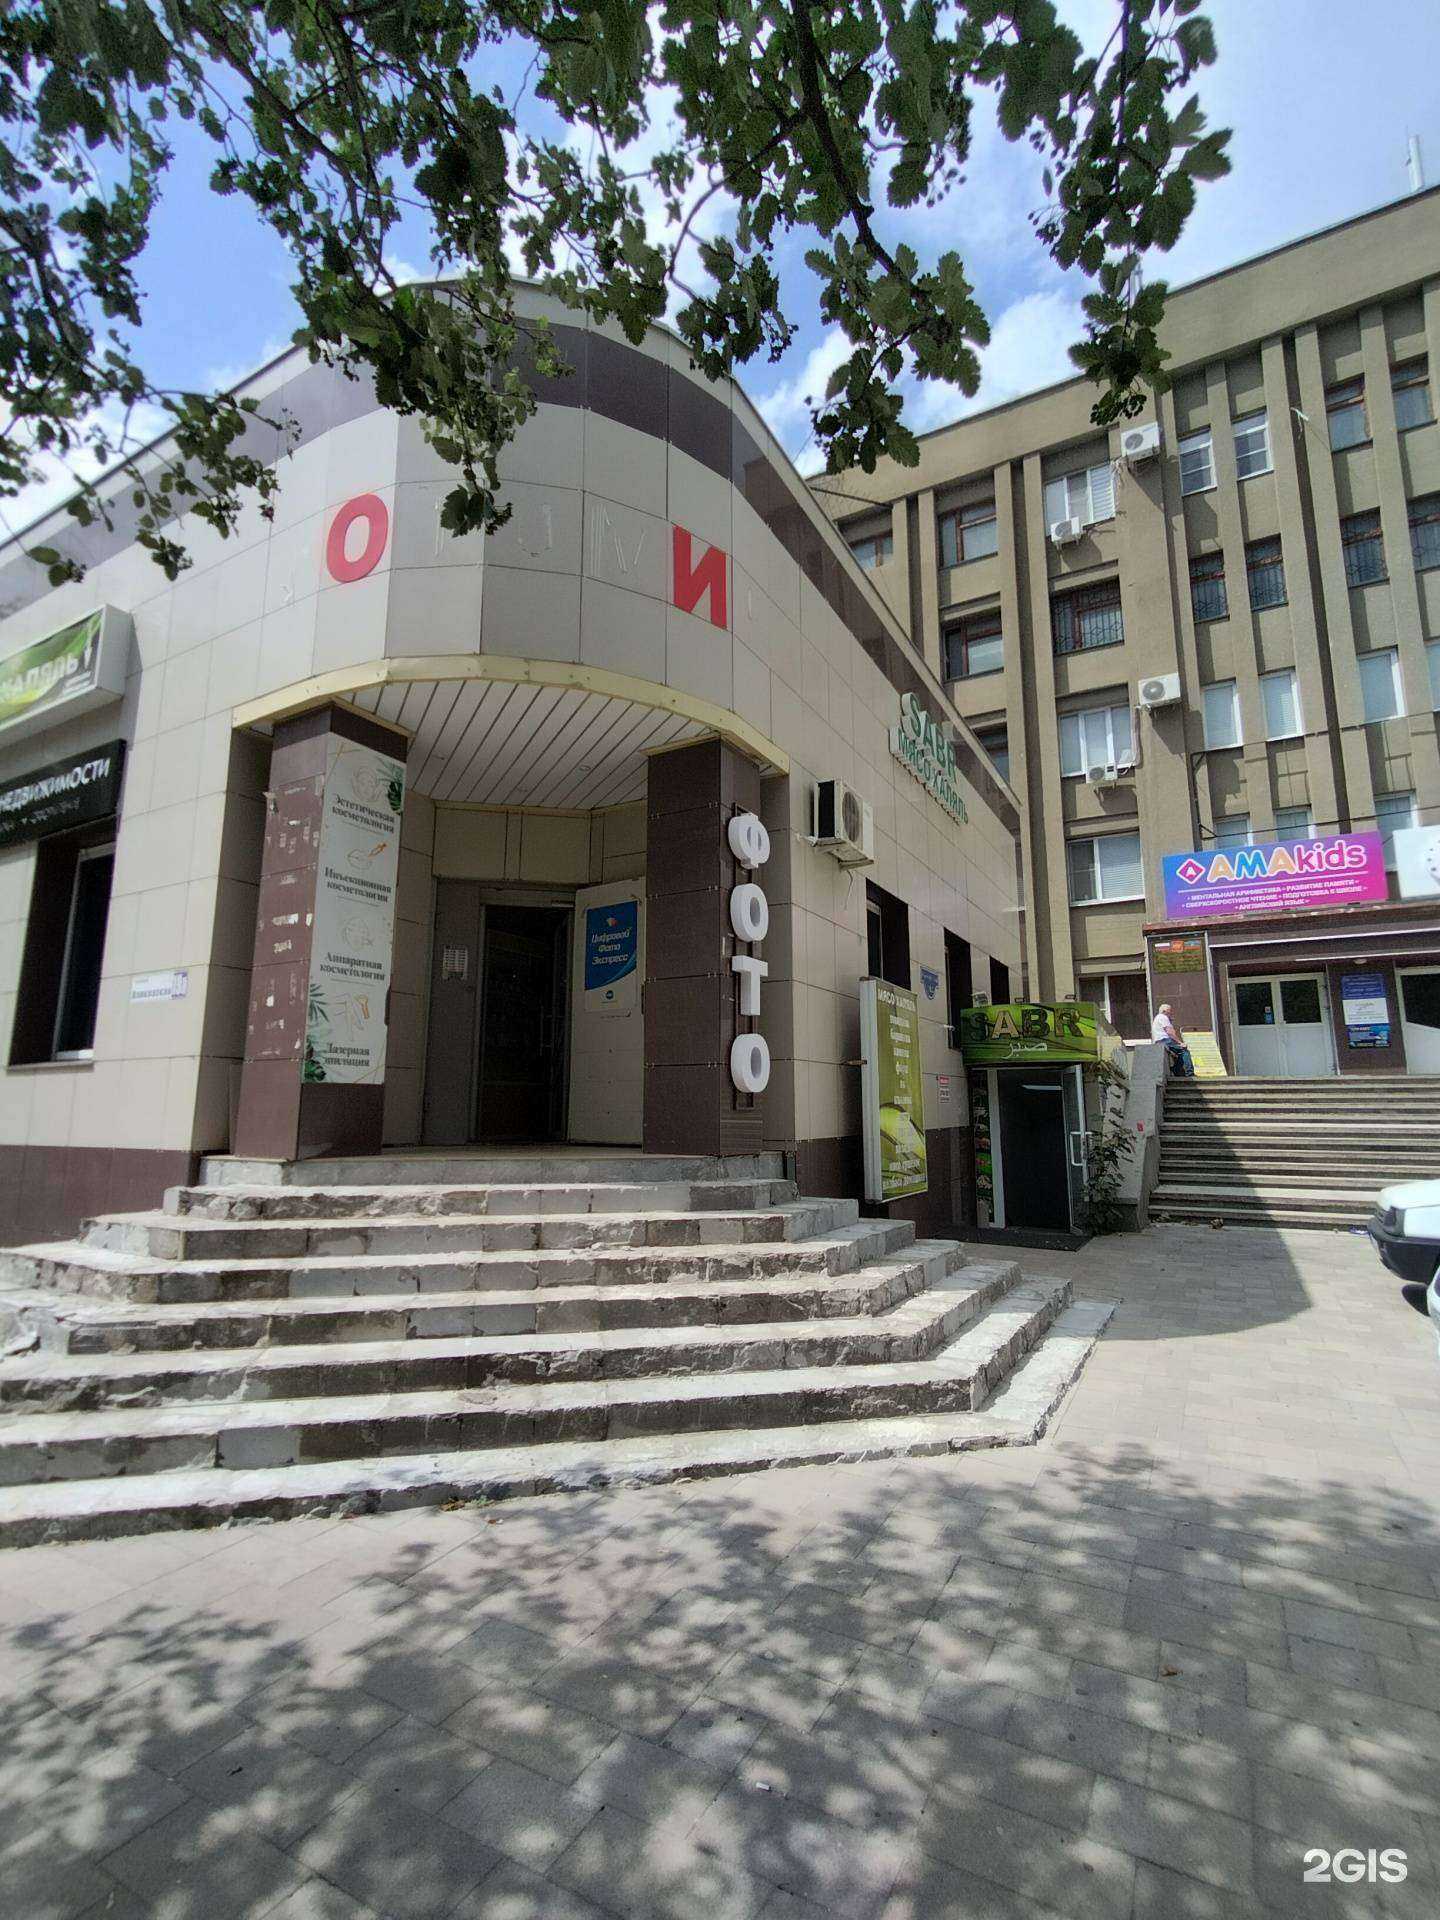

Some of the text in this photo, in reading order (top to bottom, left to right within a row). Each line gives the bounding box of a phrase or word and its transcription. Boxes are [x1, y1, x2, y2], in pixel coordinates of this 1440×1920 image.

[672, 523, 728, 630] И
[890, 726, 931, 782] МЯСО
[901, 691, 957, 784] SABR
[332, 806, 395, 834] косметология
[336, 794, 395, 823] Эстетическая
[1207, 840, 1366, 882] AMAkids
[327, 881, 388, 903] косметология
[325, 951, 383, 970] Аппаратная
[728, 812, 771, 1093] ФОТО
[319, 963, 385, 981] косметология
[969, 1007, 1084, 1040] SABR
